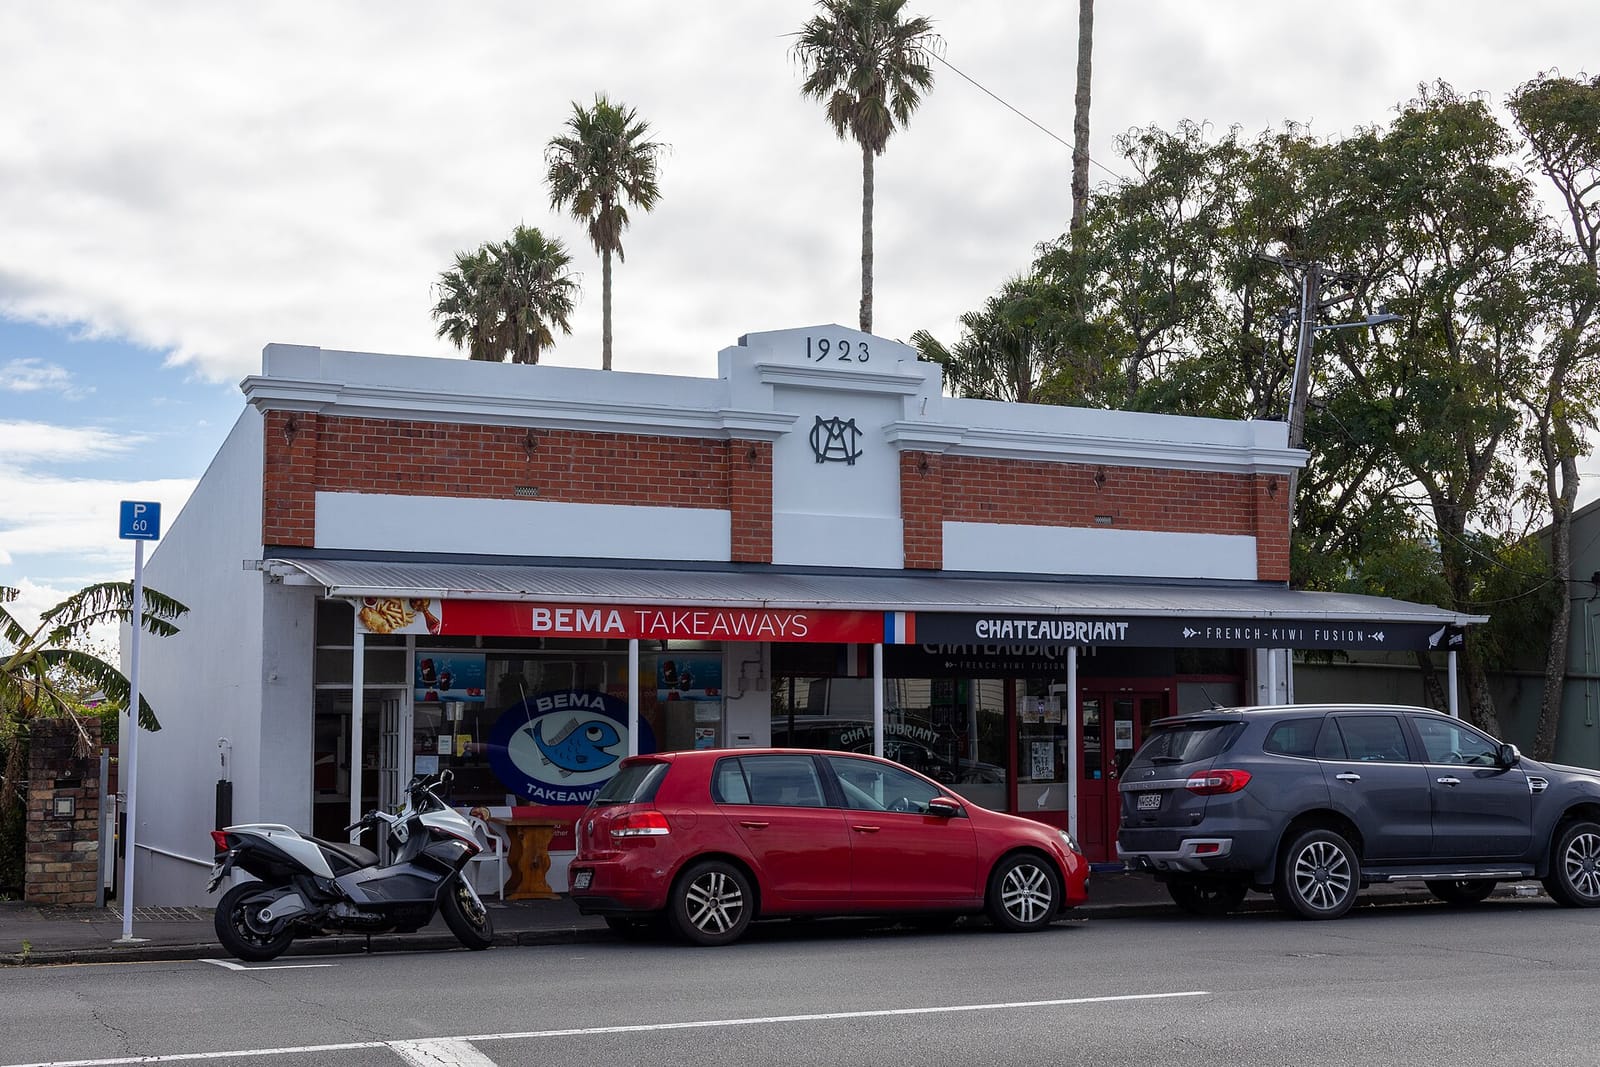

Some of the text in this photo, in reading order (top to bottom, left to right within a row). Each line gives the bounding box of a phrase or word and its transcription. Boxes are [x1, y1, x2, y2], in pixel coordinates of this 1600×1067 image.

[807, 337, 870, 362] 1923
[134, 503, 147, 518] P
[132, 520, 147, 531] 60
[532, 607, 808, 637] BEMA TAKEAWAYS
[975, 619, 1129, 643] CHATEAUBRIANT
[1206, 627, 1364, 642] FRENCH-KIWI FUSION
[536, 693, 606, 712] BEMA
[840, 723, 941, 745] CHATAUBRIANT
